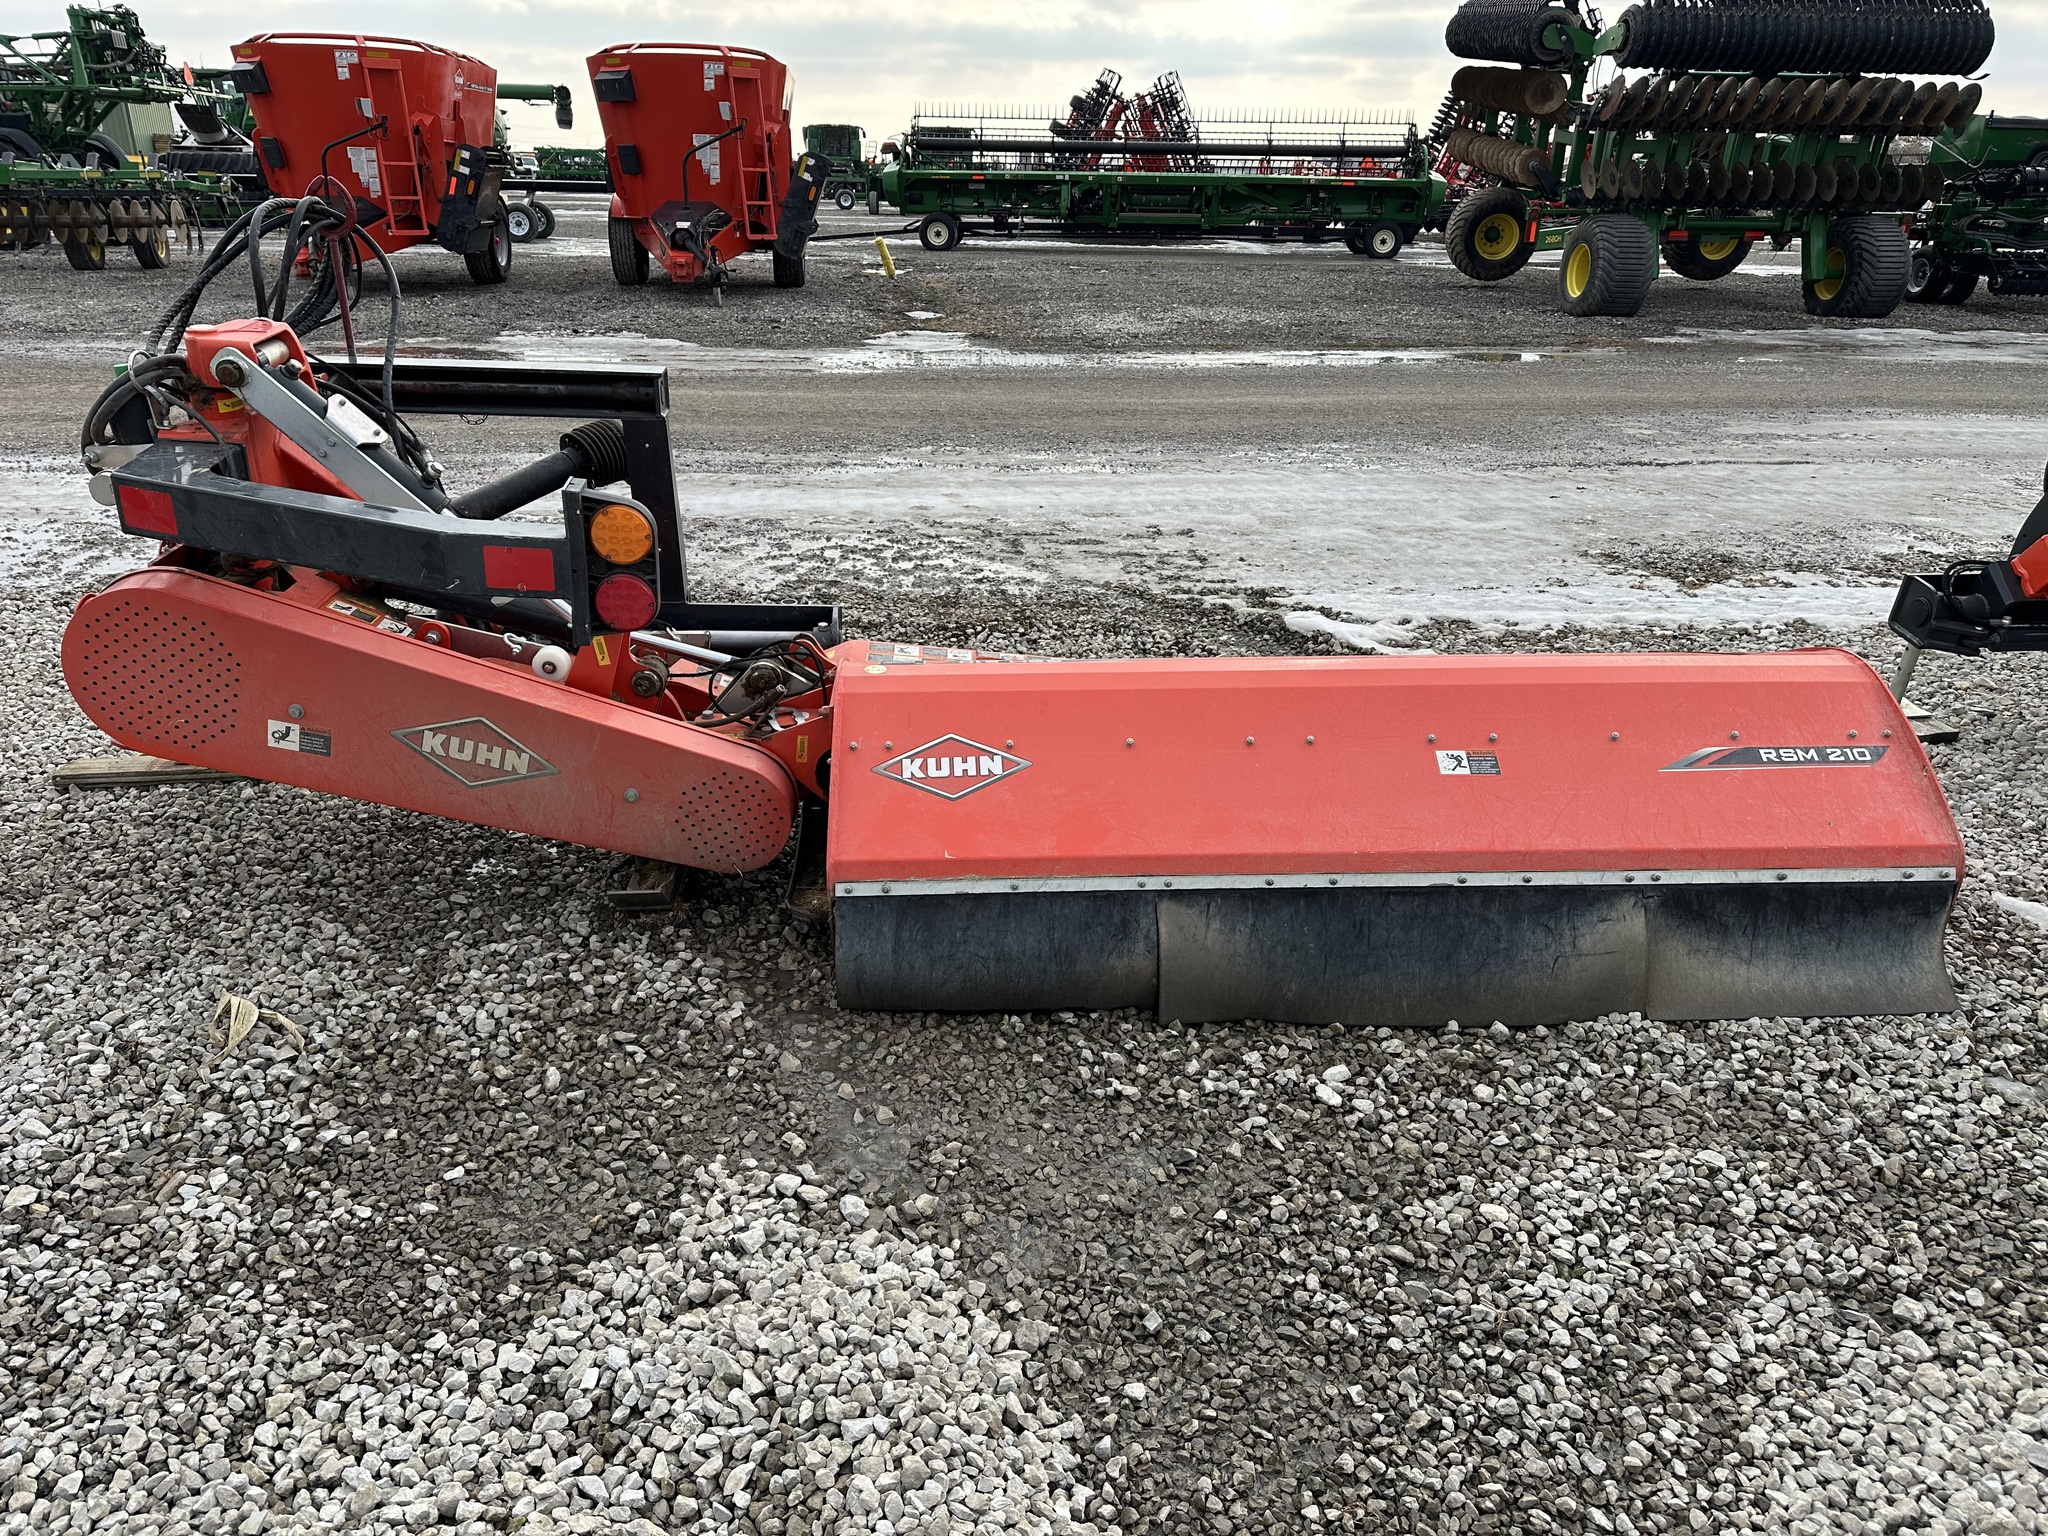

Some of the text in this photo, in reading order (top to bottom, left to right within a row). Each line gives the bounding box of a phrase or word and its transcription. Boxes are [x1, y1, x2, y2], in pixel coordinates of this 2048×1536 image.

[421, 729, 530, 775] KUHN
[1758, 748, 1872, 762] RSM 210
[902, 755, 1003, 779] KUHN
